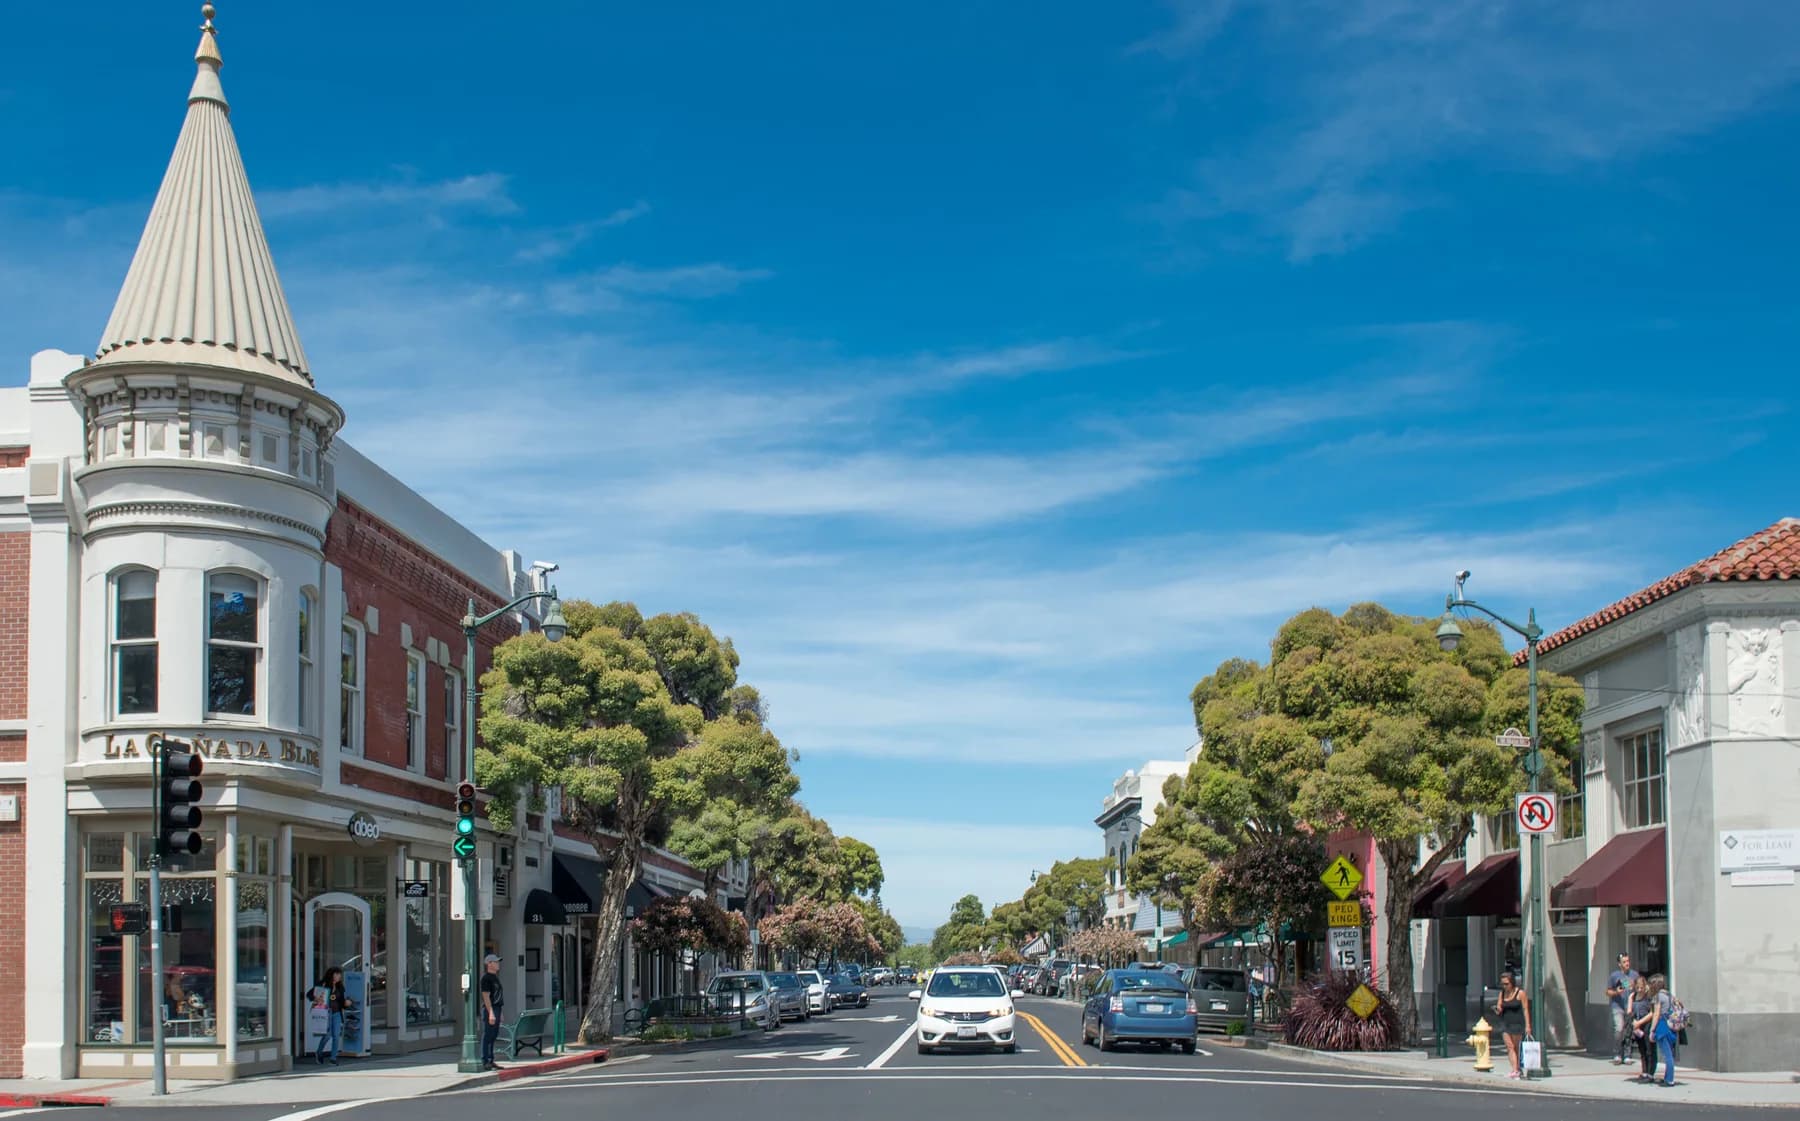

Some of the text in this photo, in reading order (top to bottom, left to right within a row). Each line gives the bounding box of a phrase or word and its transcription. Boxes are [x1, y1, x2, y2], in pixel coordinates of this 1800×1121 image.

[105, 733, 139, 760] LA
[145, 731, 272, 760] CÑADA
[354, 816, 379, 839] abeo
[1335, 905, 1353, 913] PED
[1331, 914, 1358, 923] XINGS
[1337, 950, 1356, 966] 15
